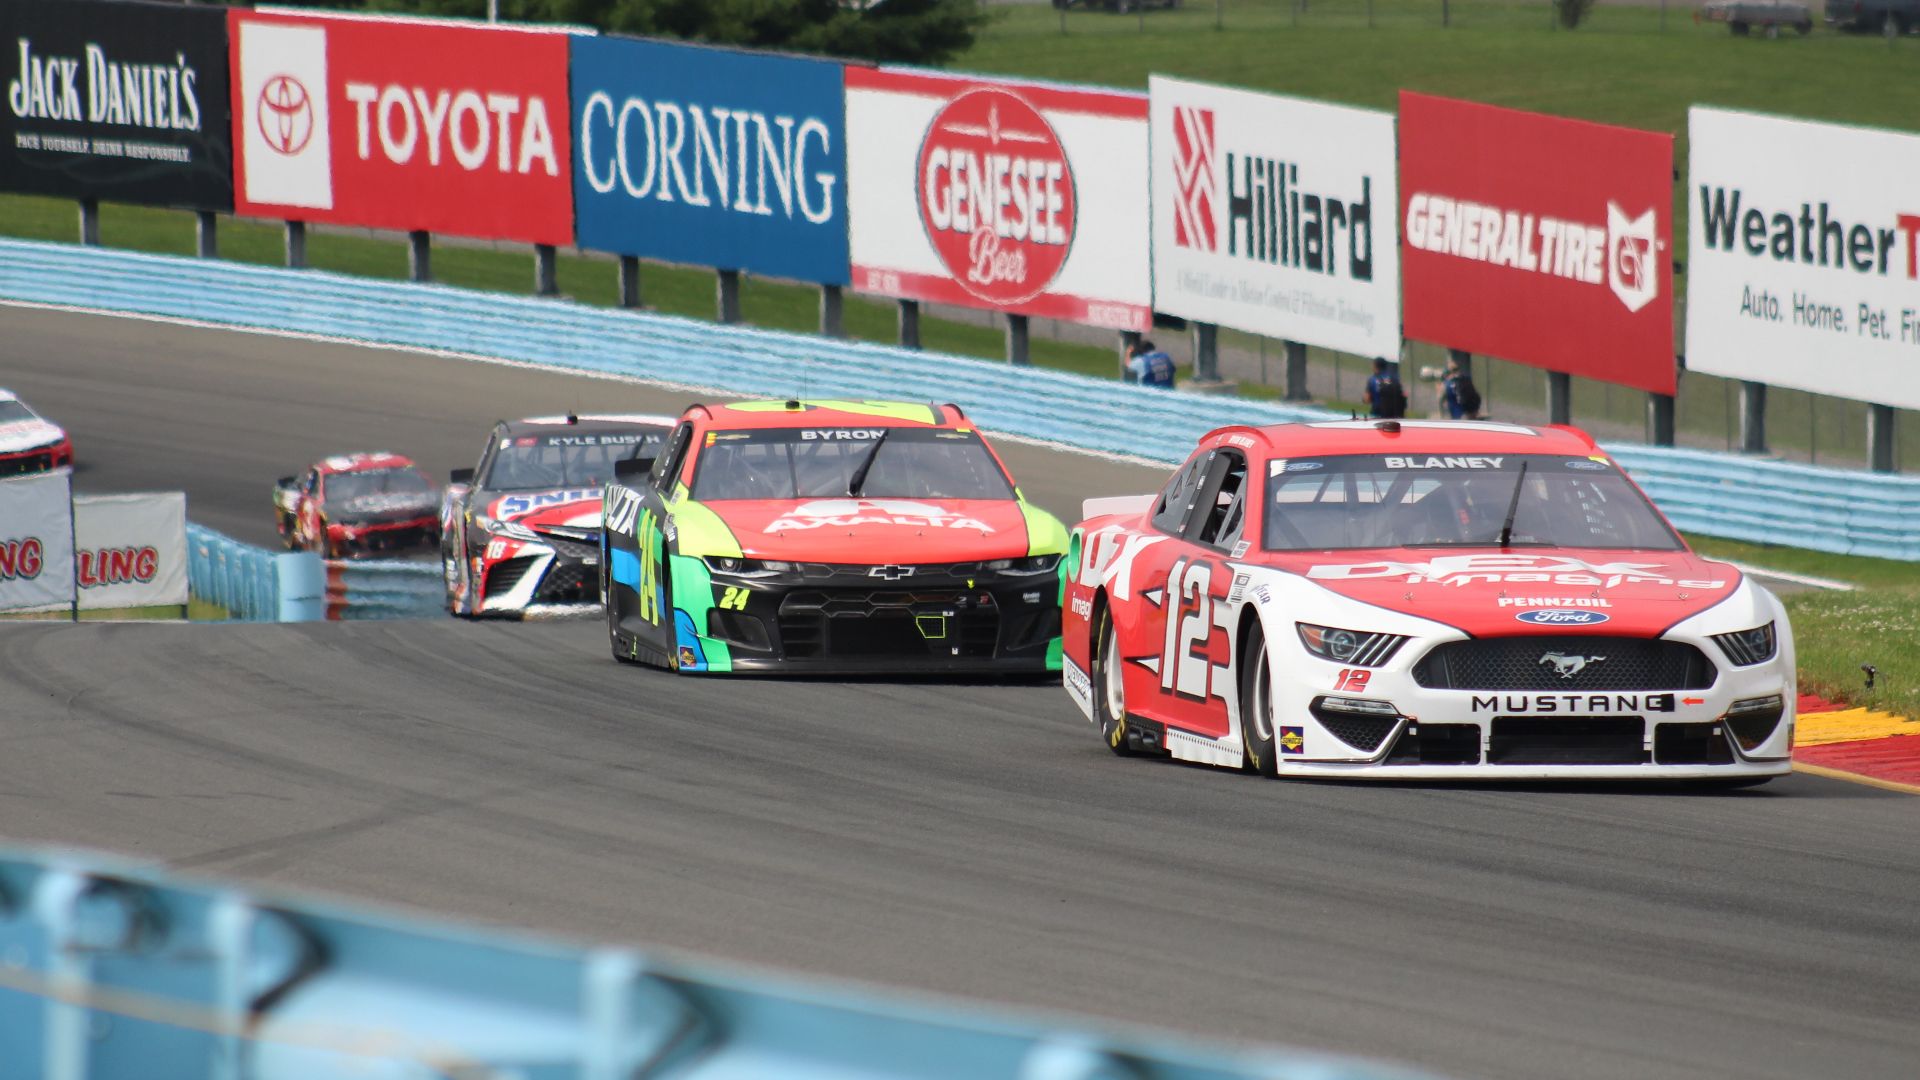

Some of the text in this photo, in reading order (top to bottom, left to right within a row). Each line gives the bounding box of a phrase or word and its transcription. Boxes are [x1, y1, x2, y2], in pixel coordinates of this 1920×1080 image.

[9, 37, 200, 132] JACK DANIEL'S
[345, 82, 560, 177] TOYOTA
[581, 91, 836, 225] CORNING
[926, 146, 1067, 247] GENESEE
[1226, 152, 1373, 283] Hilliard
[1406, 193, 1605, 285] GENERAL TIRE
[968, 225, 1028, 286] Beer
[1739, 283, 1784, 323] Auto.
[1792, 290, 1848, 333] Home.
[1857, 302, 1891, 340] Pet.
[548, 434, 597, 446] KYLE
[801, 430, 888, 442] BYRON
[1384, 457, 1505, 469] BLANEY
[763, 515, 995, 534] AXALTA
[486, 540, 507, 561] 18
[1306, 554, 1672, 580] DEX
[719, 586, 751, 611] 24
[1498, 597, 1613, 609] PENNZOIL
[1161, 557, 1212, 701] 12
[1533, 610, 1592, 624] Ford
[1333, 668, 1372, 693] 12
[1471, 695, 1661, 712] MUSTANG
